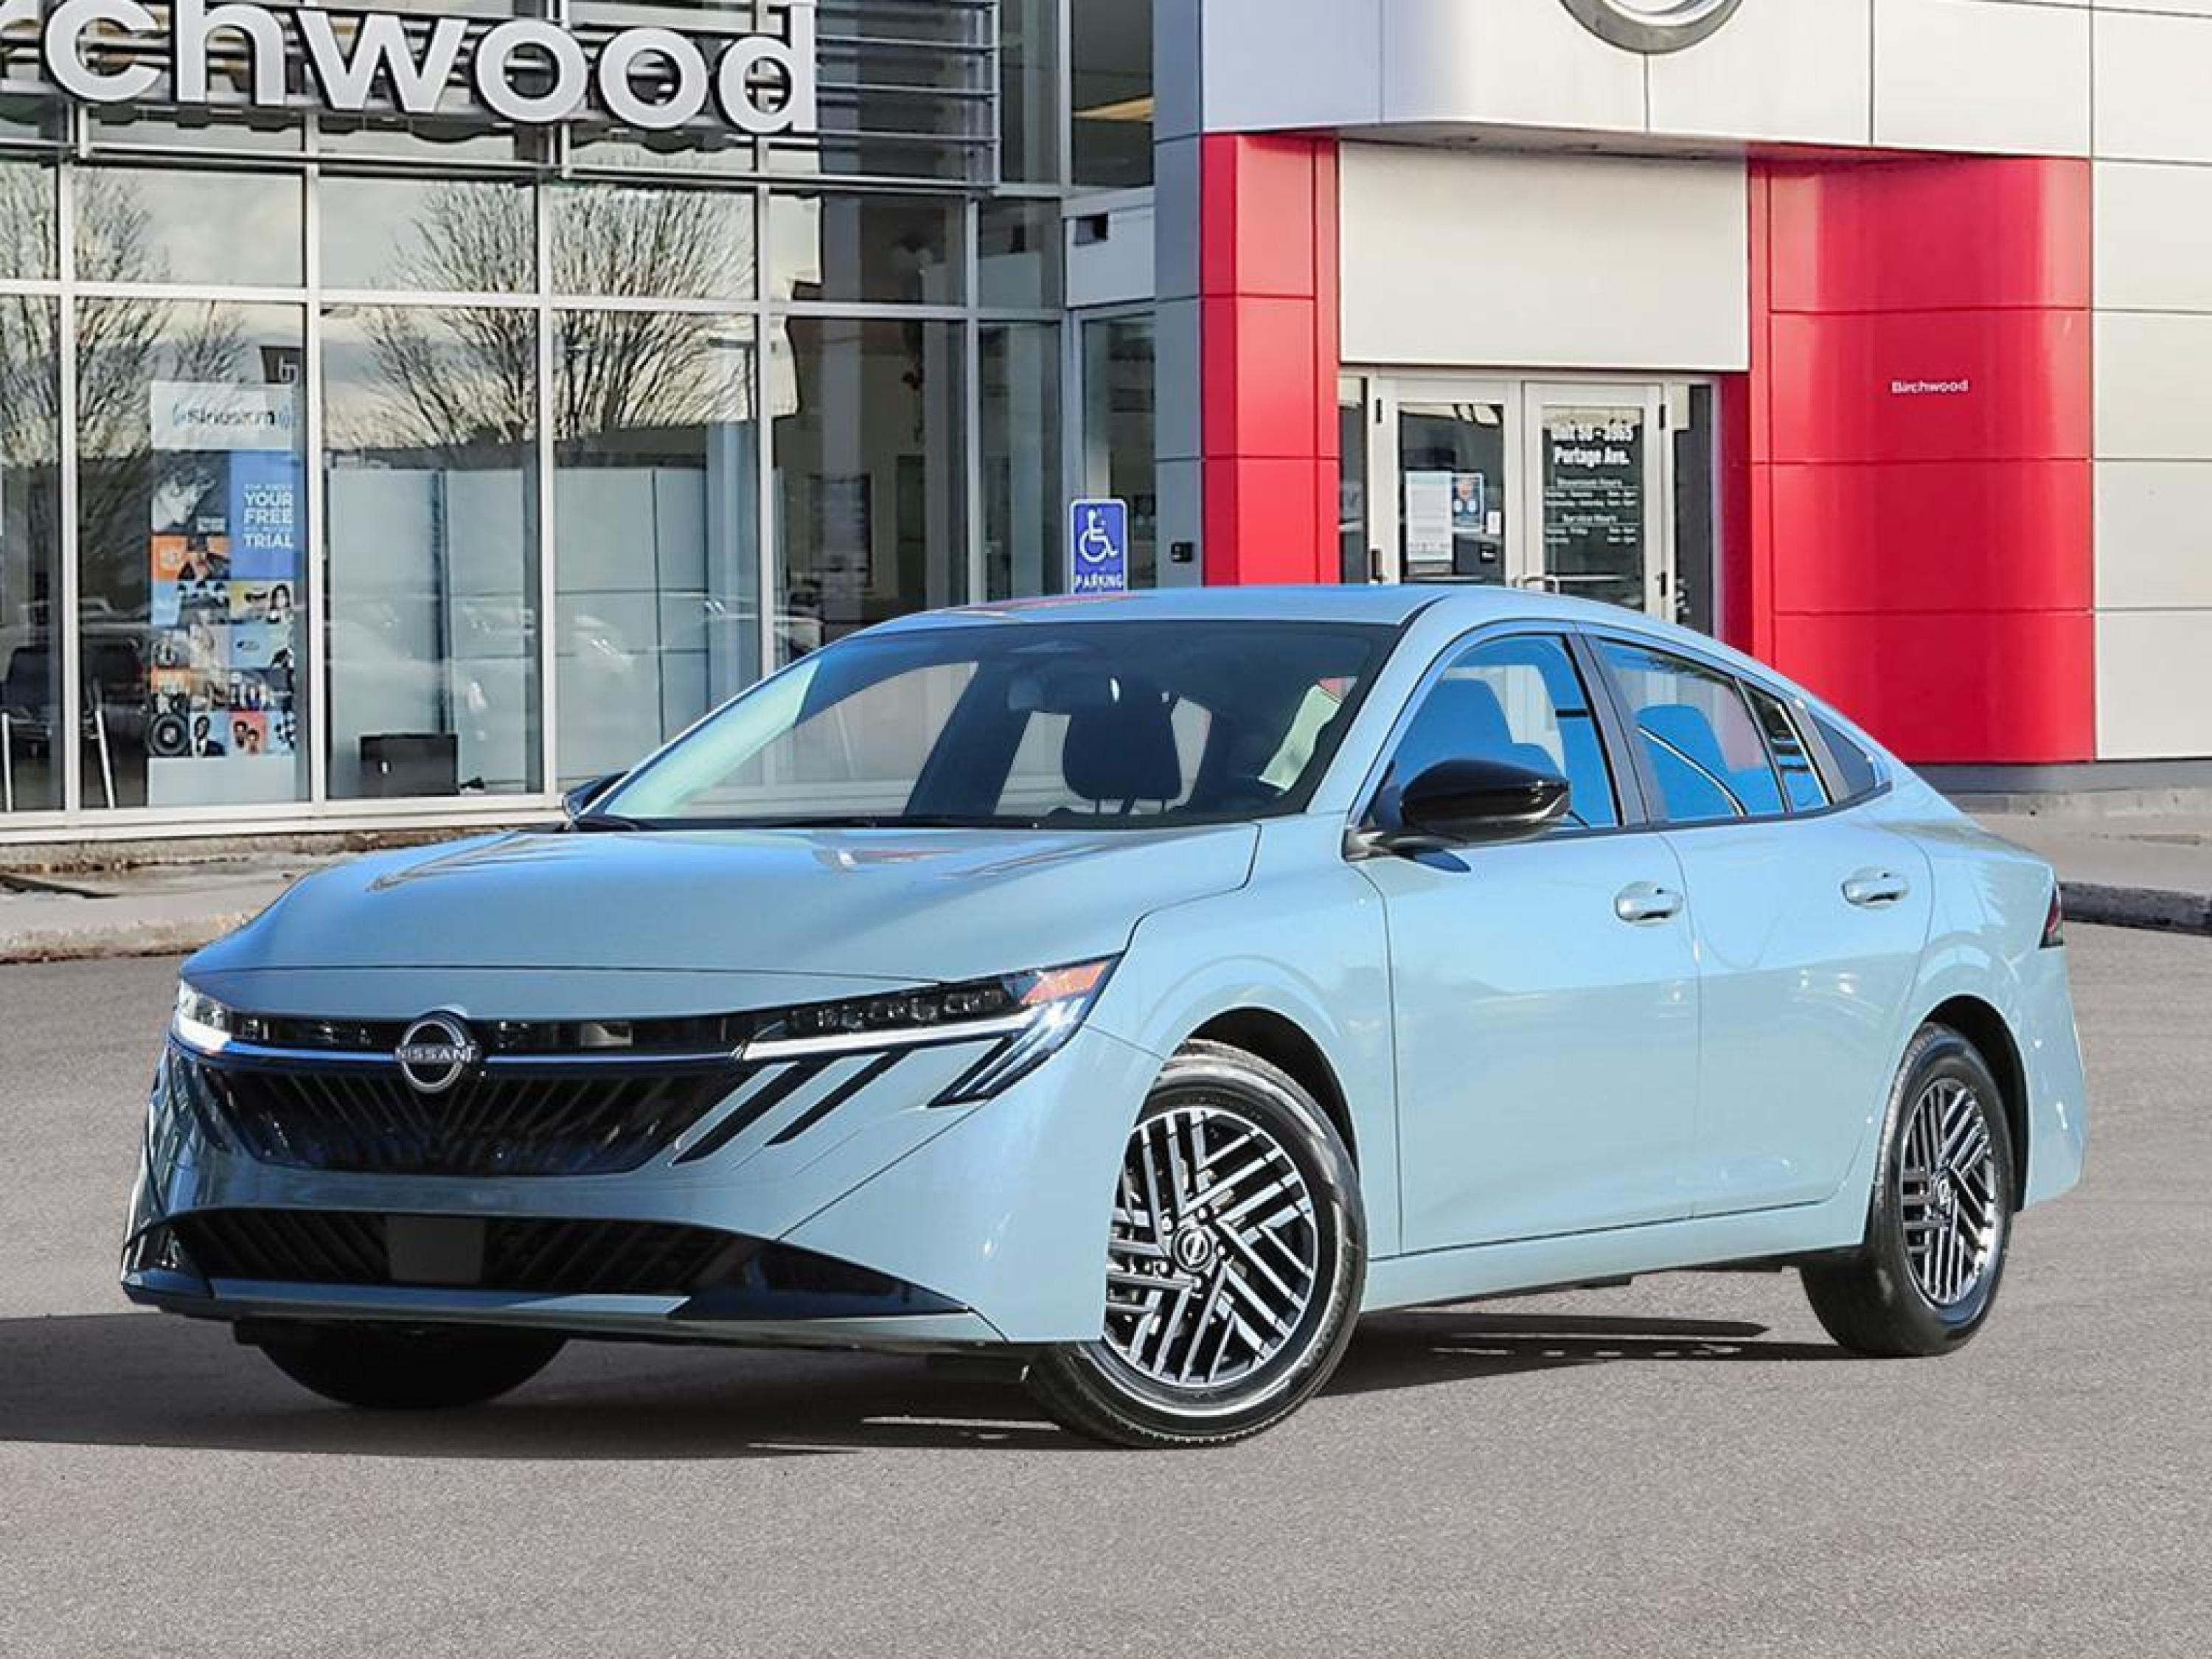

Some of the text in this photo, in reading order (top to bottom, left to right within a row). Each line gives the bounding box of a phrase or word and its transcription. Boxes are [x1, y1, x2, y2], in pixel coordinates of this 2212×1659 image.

[1892, 379, 1969, 394] Birchwood
[1554, 446, 1630, 467] Portage Ave.
[243, 491, 293, 506] YOUR
[243, 507, 293, 524] FREE
[243, 533, 294, 549] TRIAL
[1073, 573, 1124, 588] PARKING
[394, 1045, 472, 1063] NISSAN
